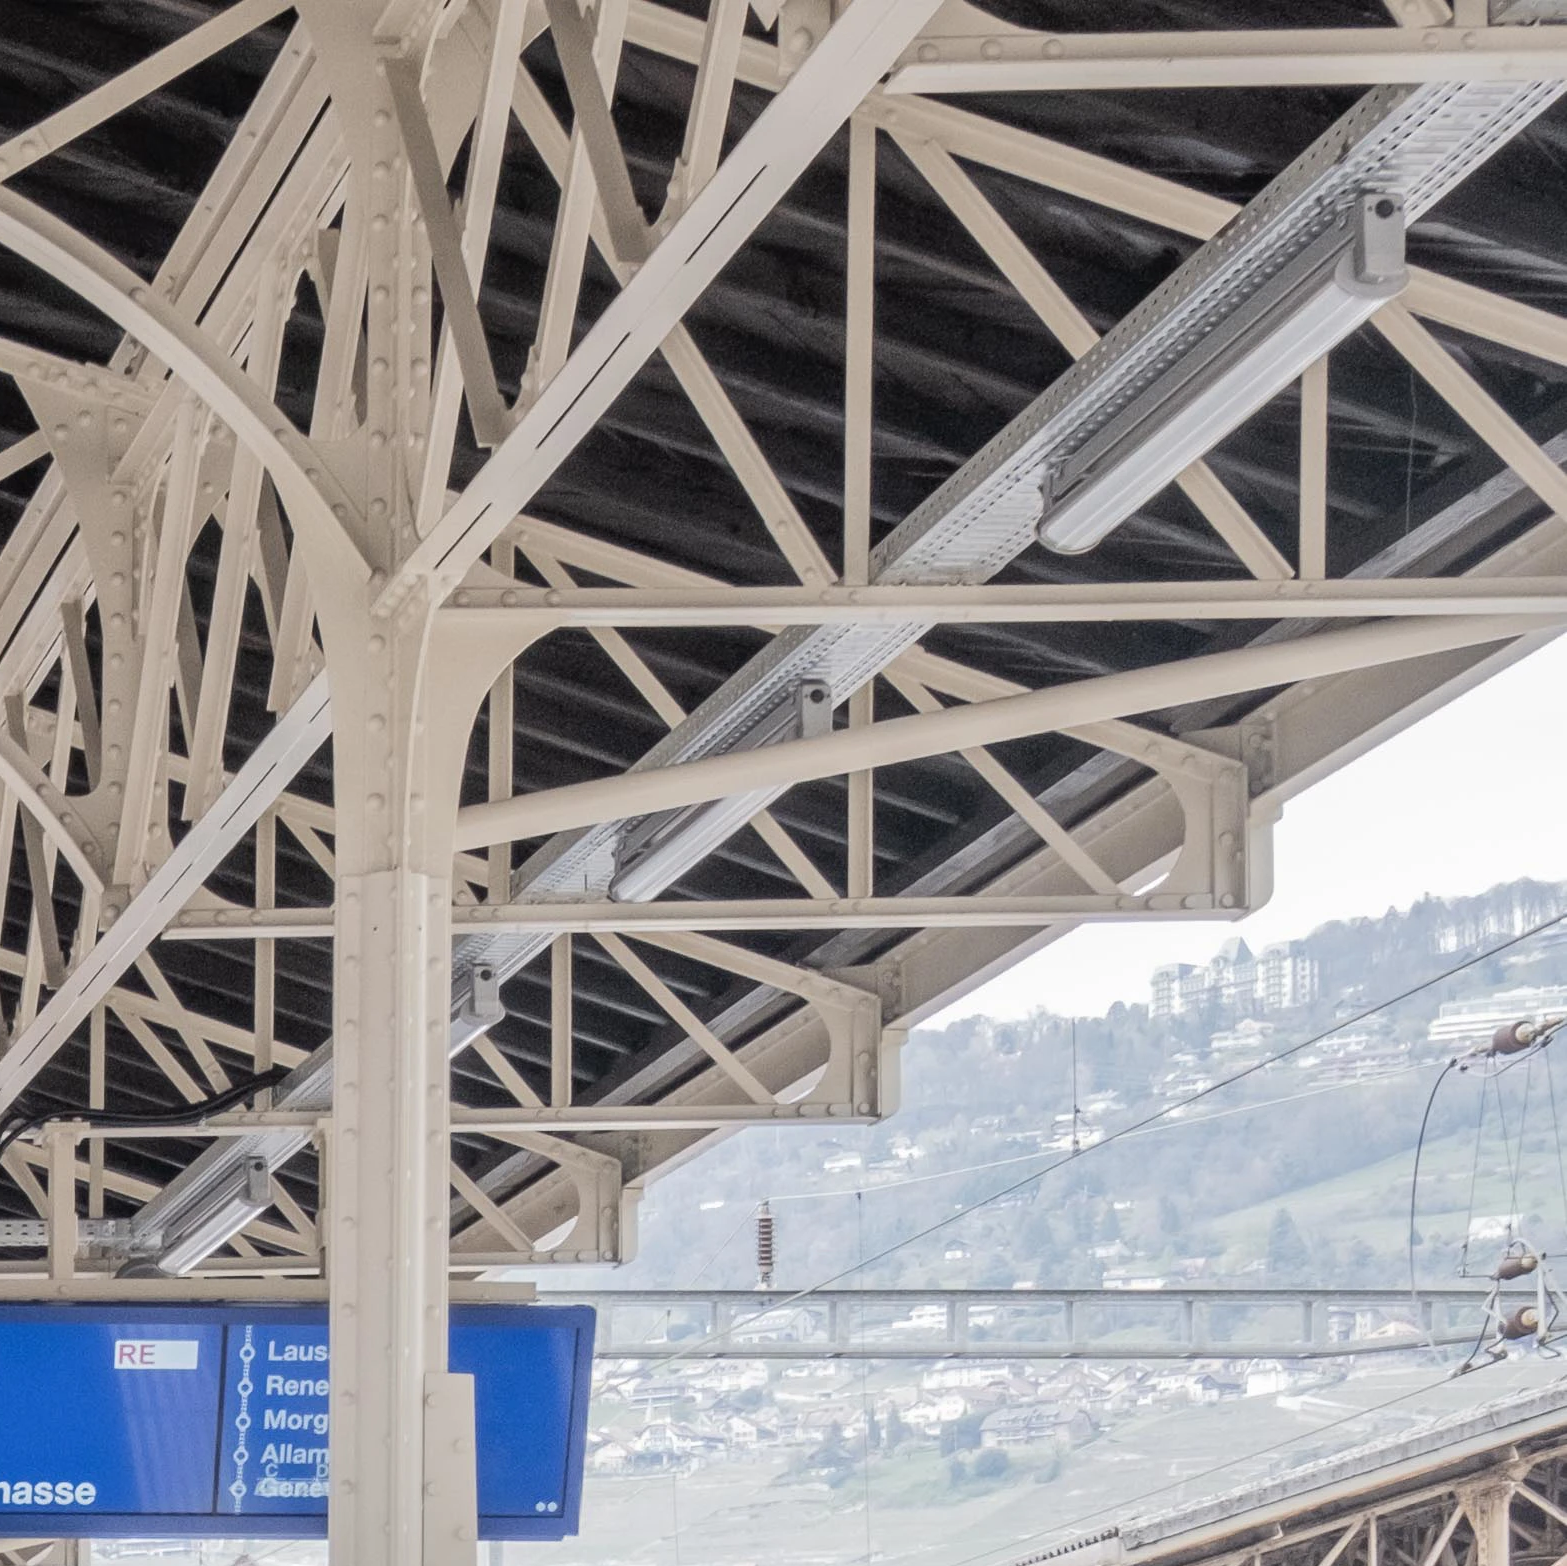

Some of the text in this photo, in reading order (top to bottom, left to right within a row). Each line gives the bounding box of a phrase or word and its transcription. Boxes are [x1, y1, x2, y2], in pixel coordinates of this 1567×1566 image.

[119, 1344, 156, 1365] RE
[266, 1375, 329, 1396] Rene
[264, 1409, 328, 1434] Morg
